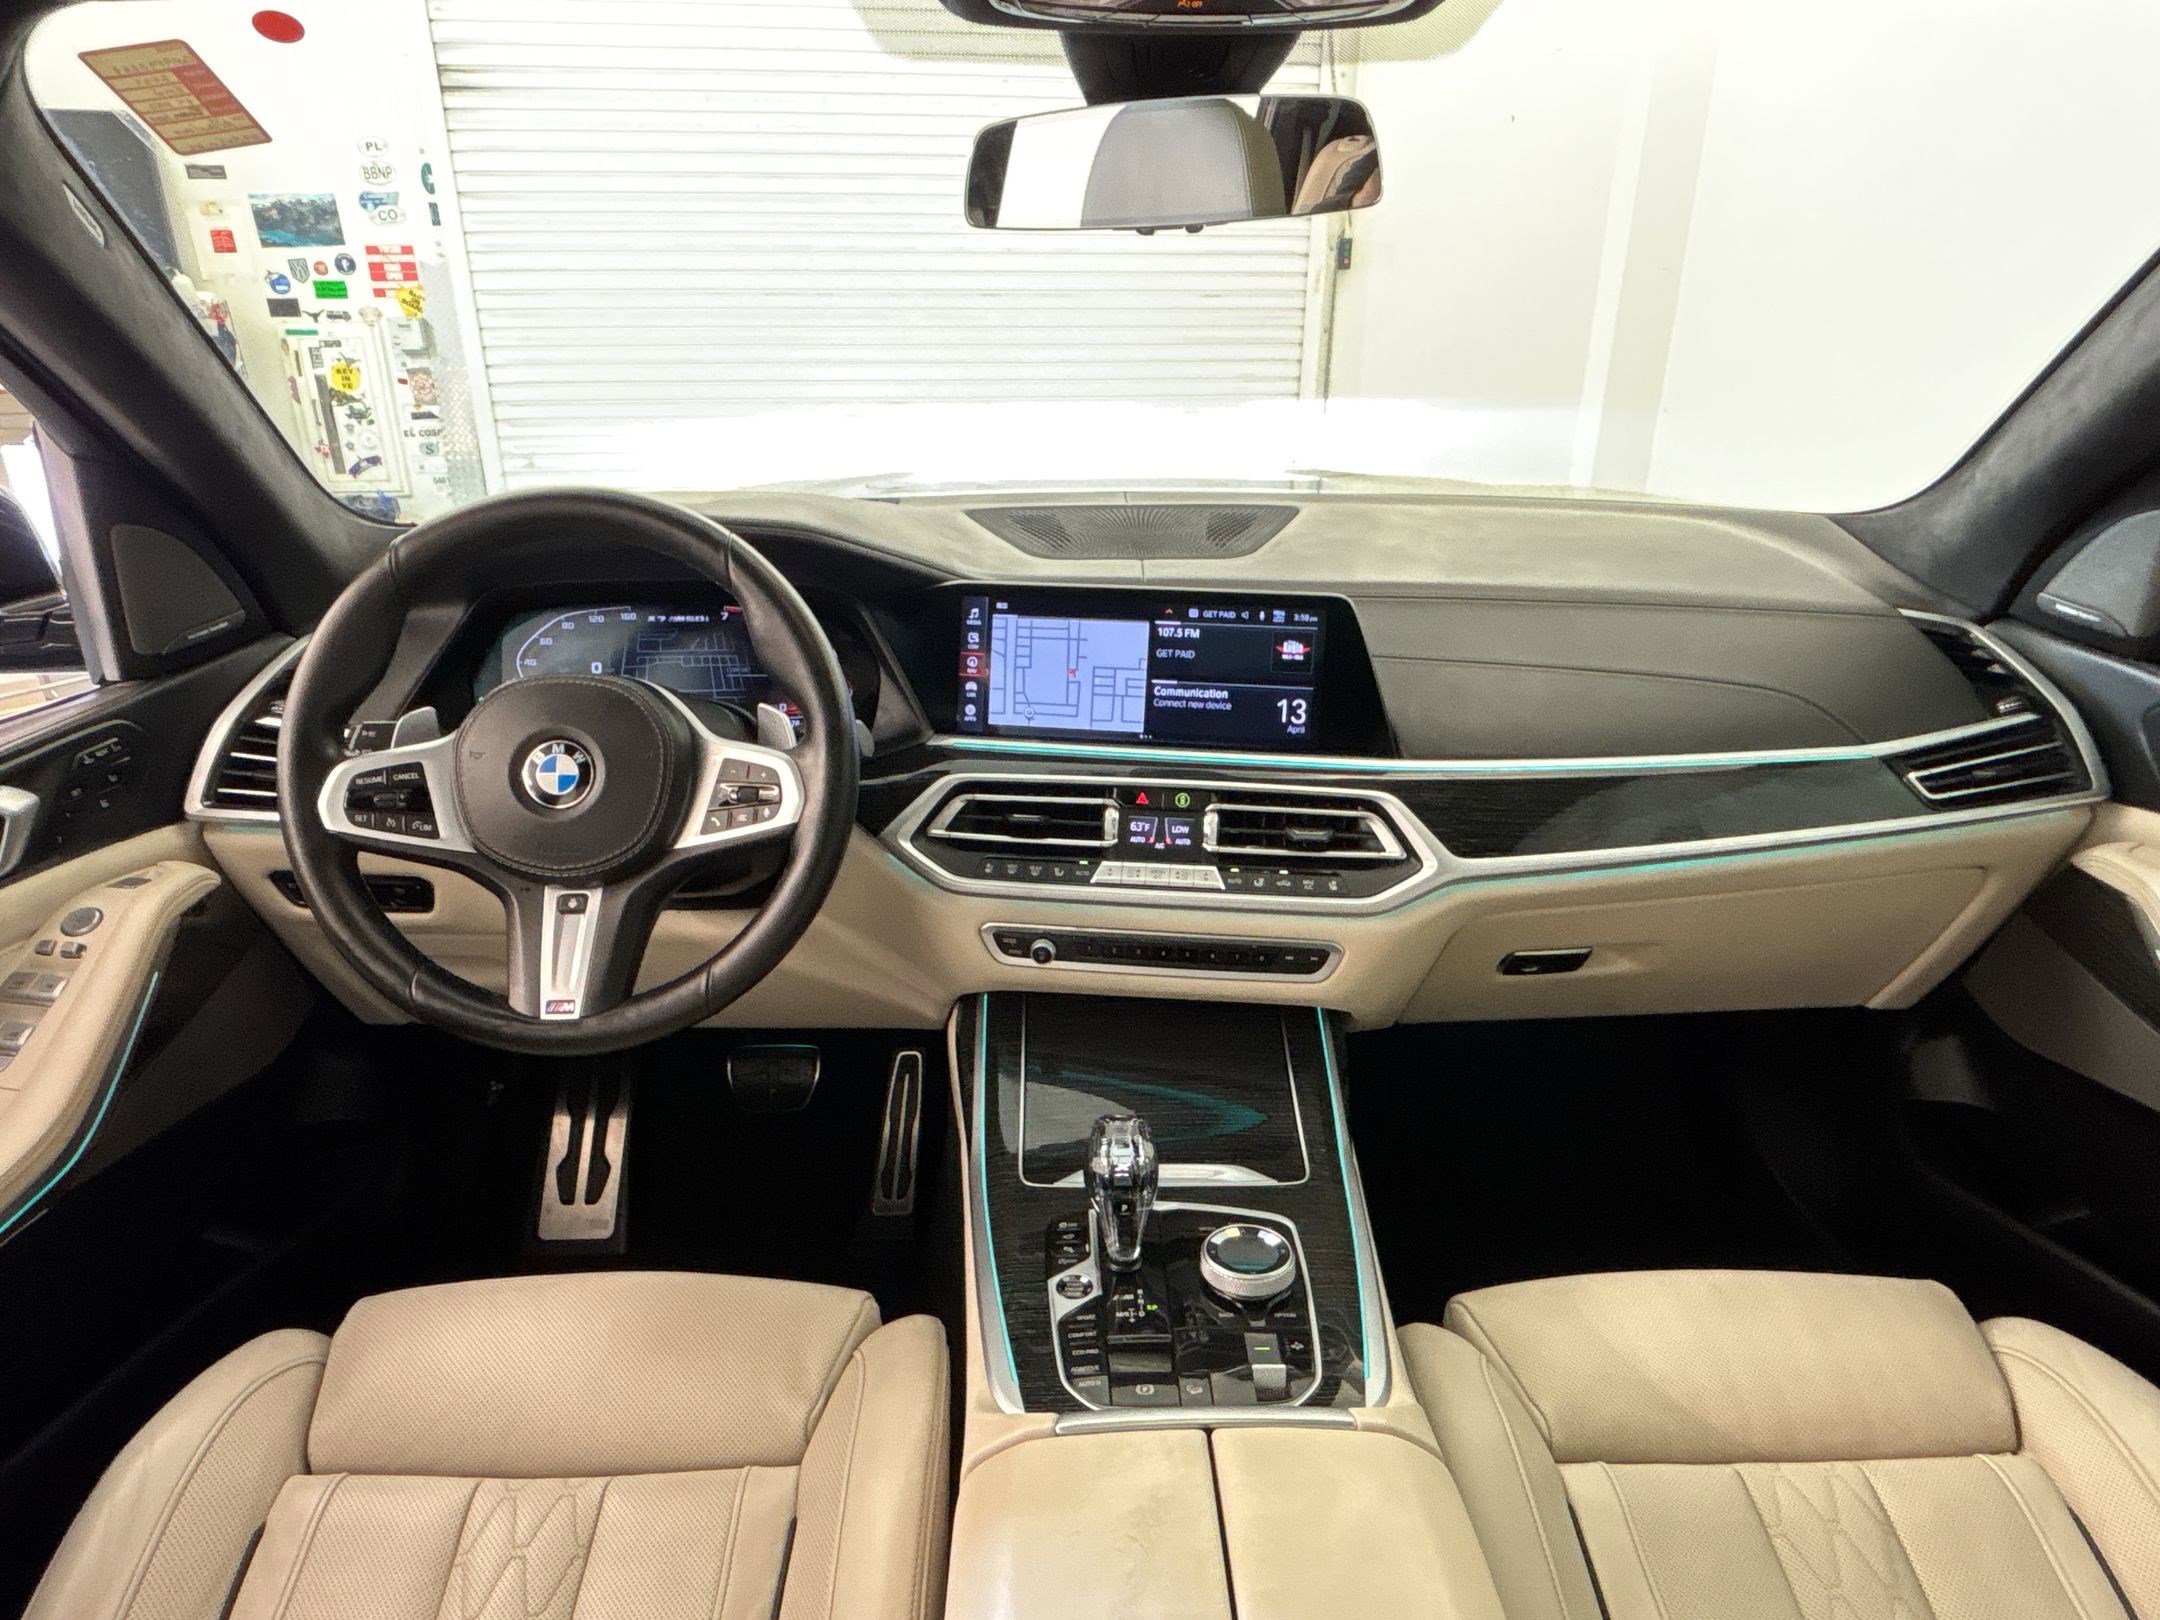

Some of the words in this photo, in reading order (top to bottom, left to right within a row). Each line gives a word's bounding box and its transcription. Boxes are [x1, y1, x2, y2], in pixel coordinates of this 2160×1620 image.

[1202, 610, 1218, 618] GET
[1218, 610, 1236, 620] PAID
[1157, 627, 1182, 638] 107.5
[1184, 628, 1200, 638] FM
[1156, 648, 1174, 658] GET
[1174, 650, 1196, 660] PAID
[591, 662, 602, 674] 0
[1154, 686, 1228, 699] Communication
[1153, 699, 1186, 708] Connect
[1206, 701, 1232, 710] device
[1276, 698, 1306, 725] 13
[1286, 725, 1306, 734] April
[531, 743, 587, 764] BMW
[392, 772, 420, 781] CANCEL
[354, 814, 368, 822] SET
[1172, 825, 1189, 834] LOW
